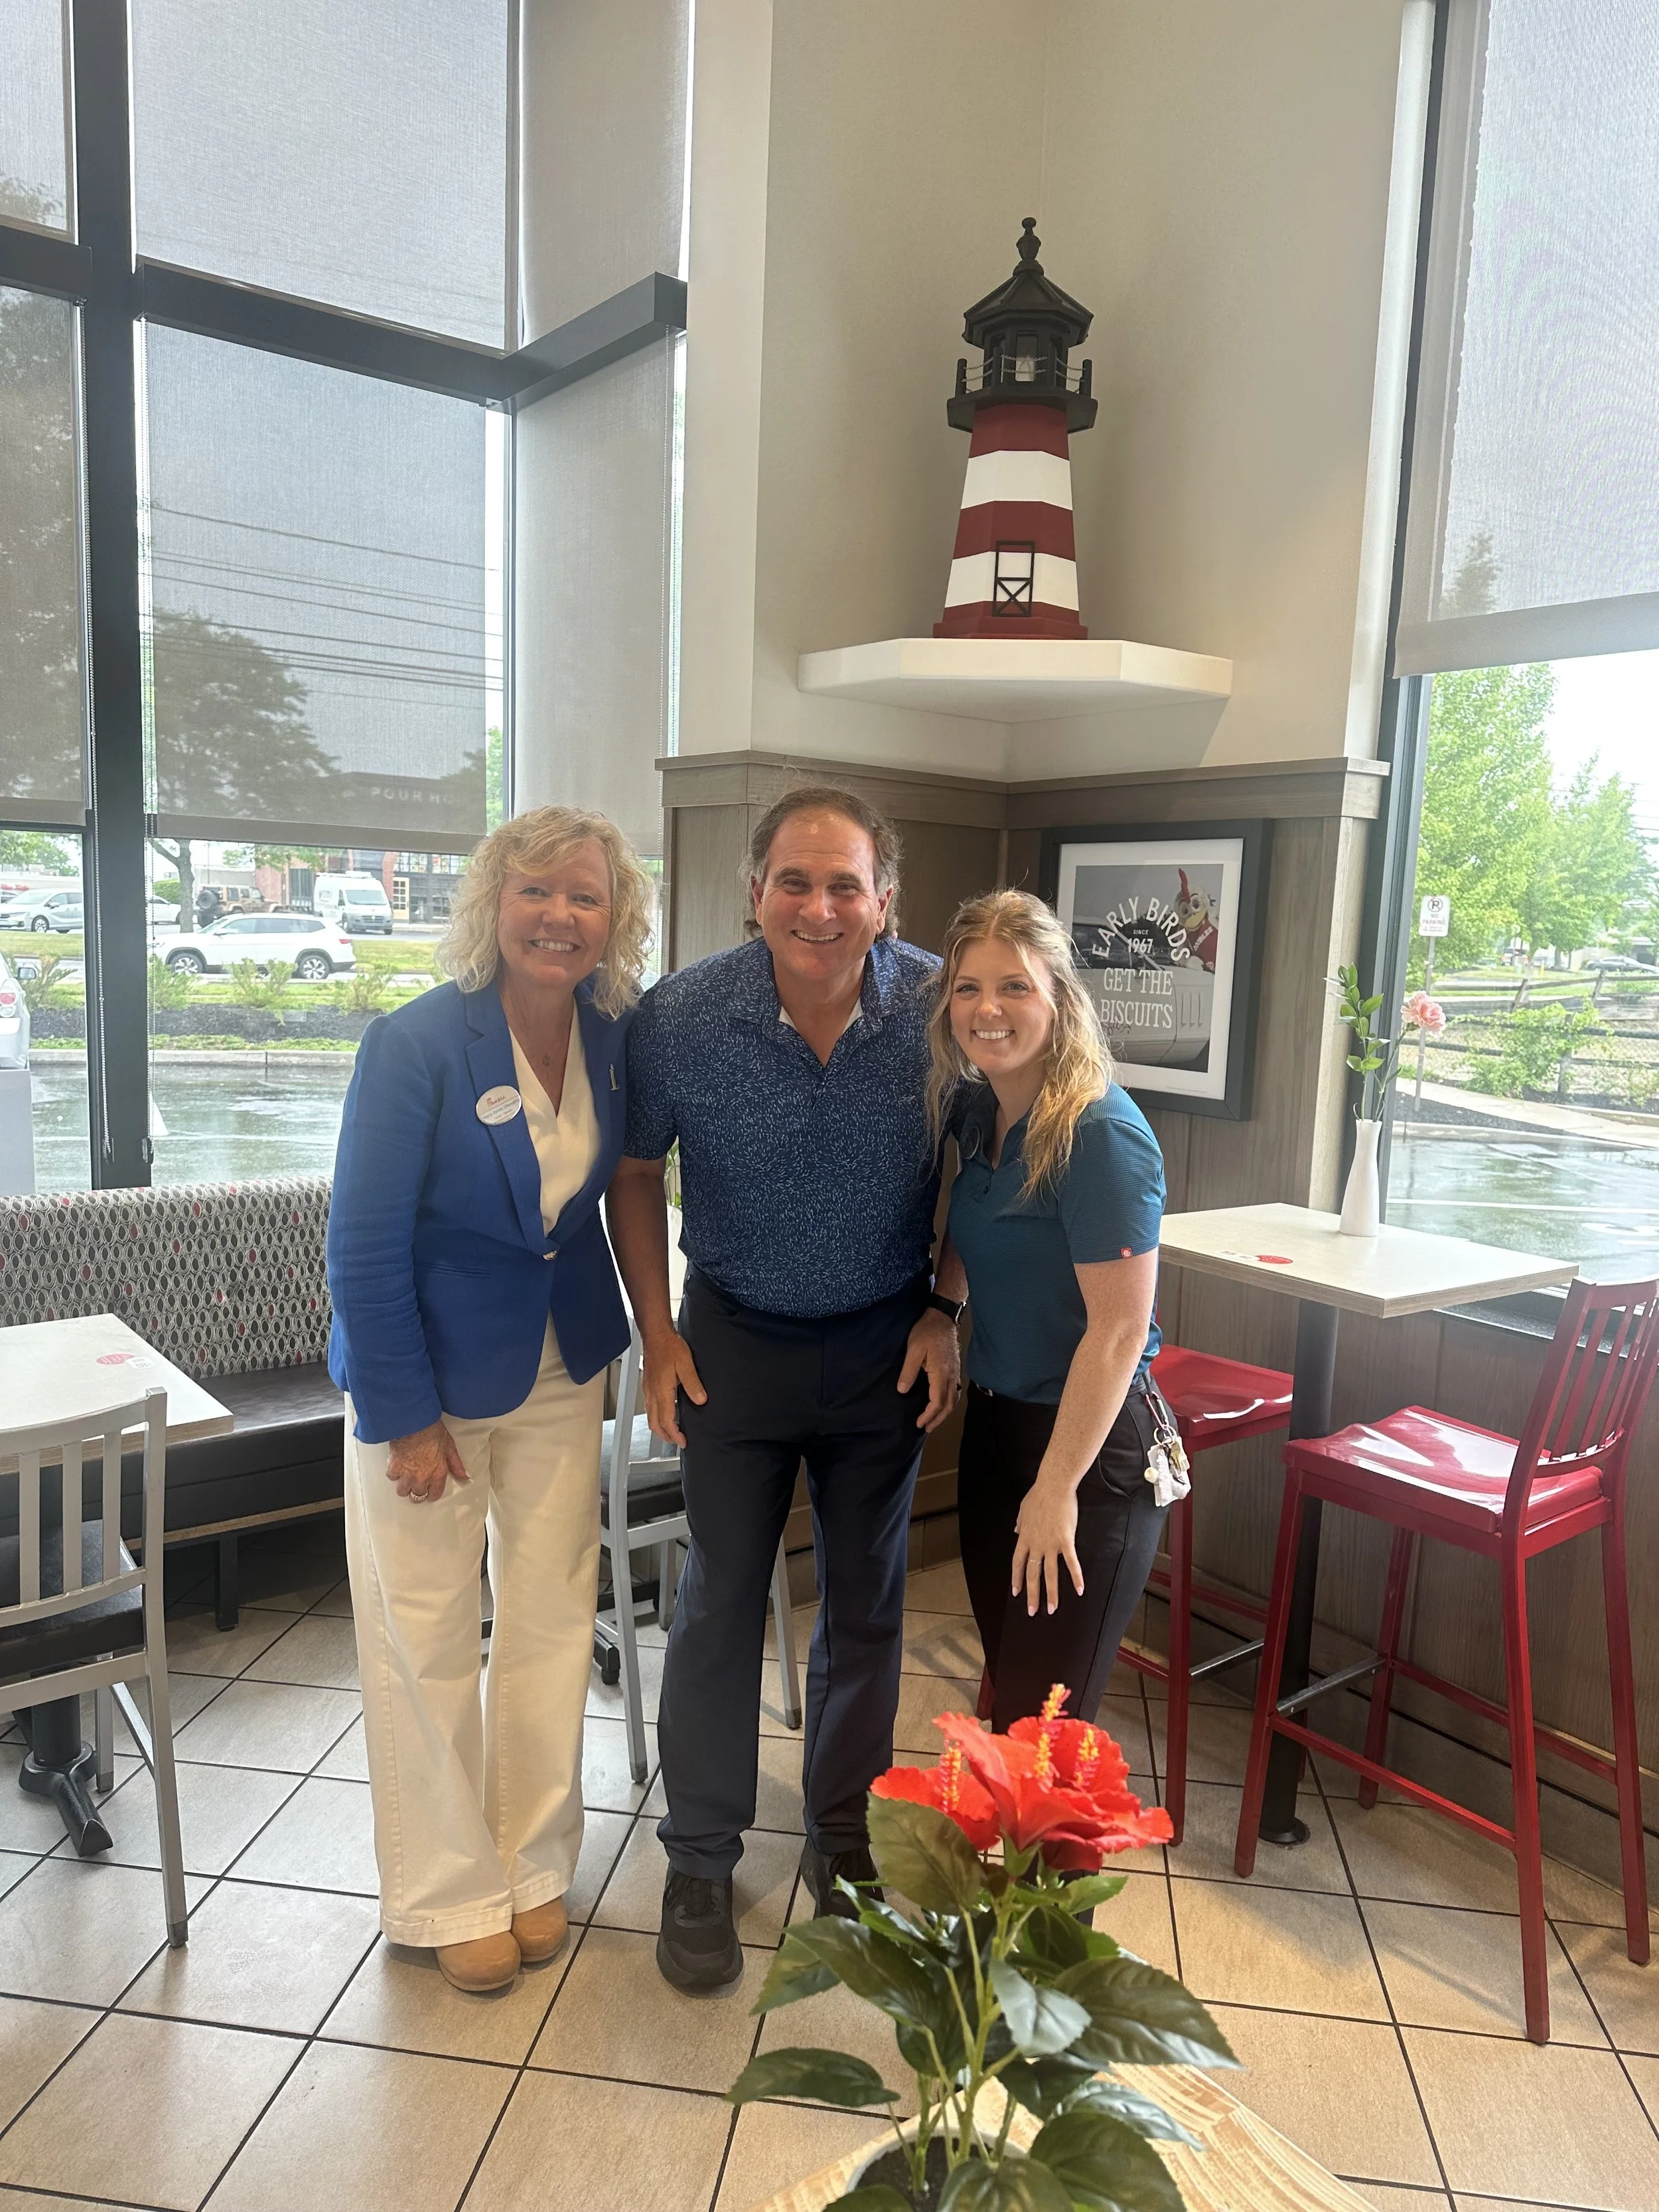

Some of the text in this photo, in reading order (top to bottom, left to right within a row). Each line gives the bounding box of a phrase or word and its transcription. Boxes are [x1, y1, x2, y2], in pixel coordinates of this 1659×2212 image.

[1092, 896, 1190, 962] EARLY BIRDS
[1128, 938, 1153, 954] 1967
[1104, 967, 1173, 995] GET THE
[1100, 999, 1173, 1029] BISCUITS
